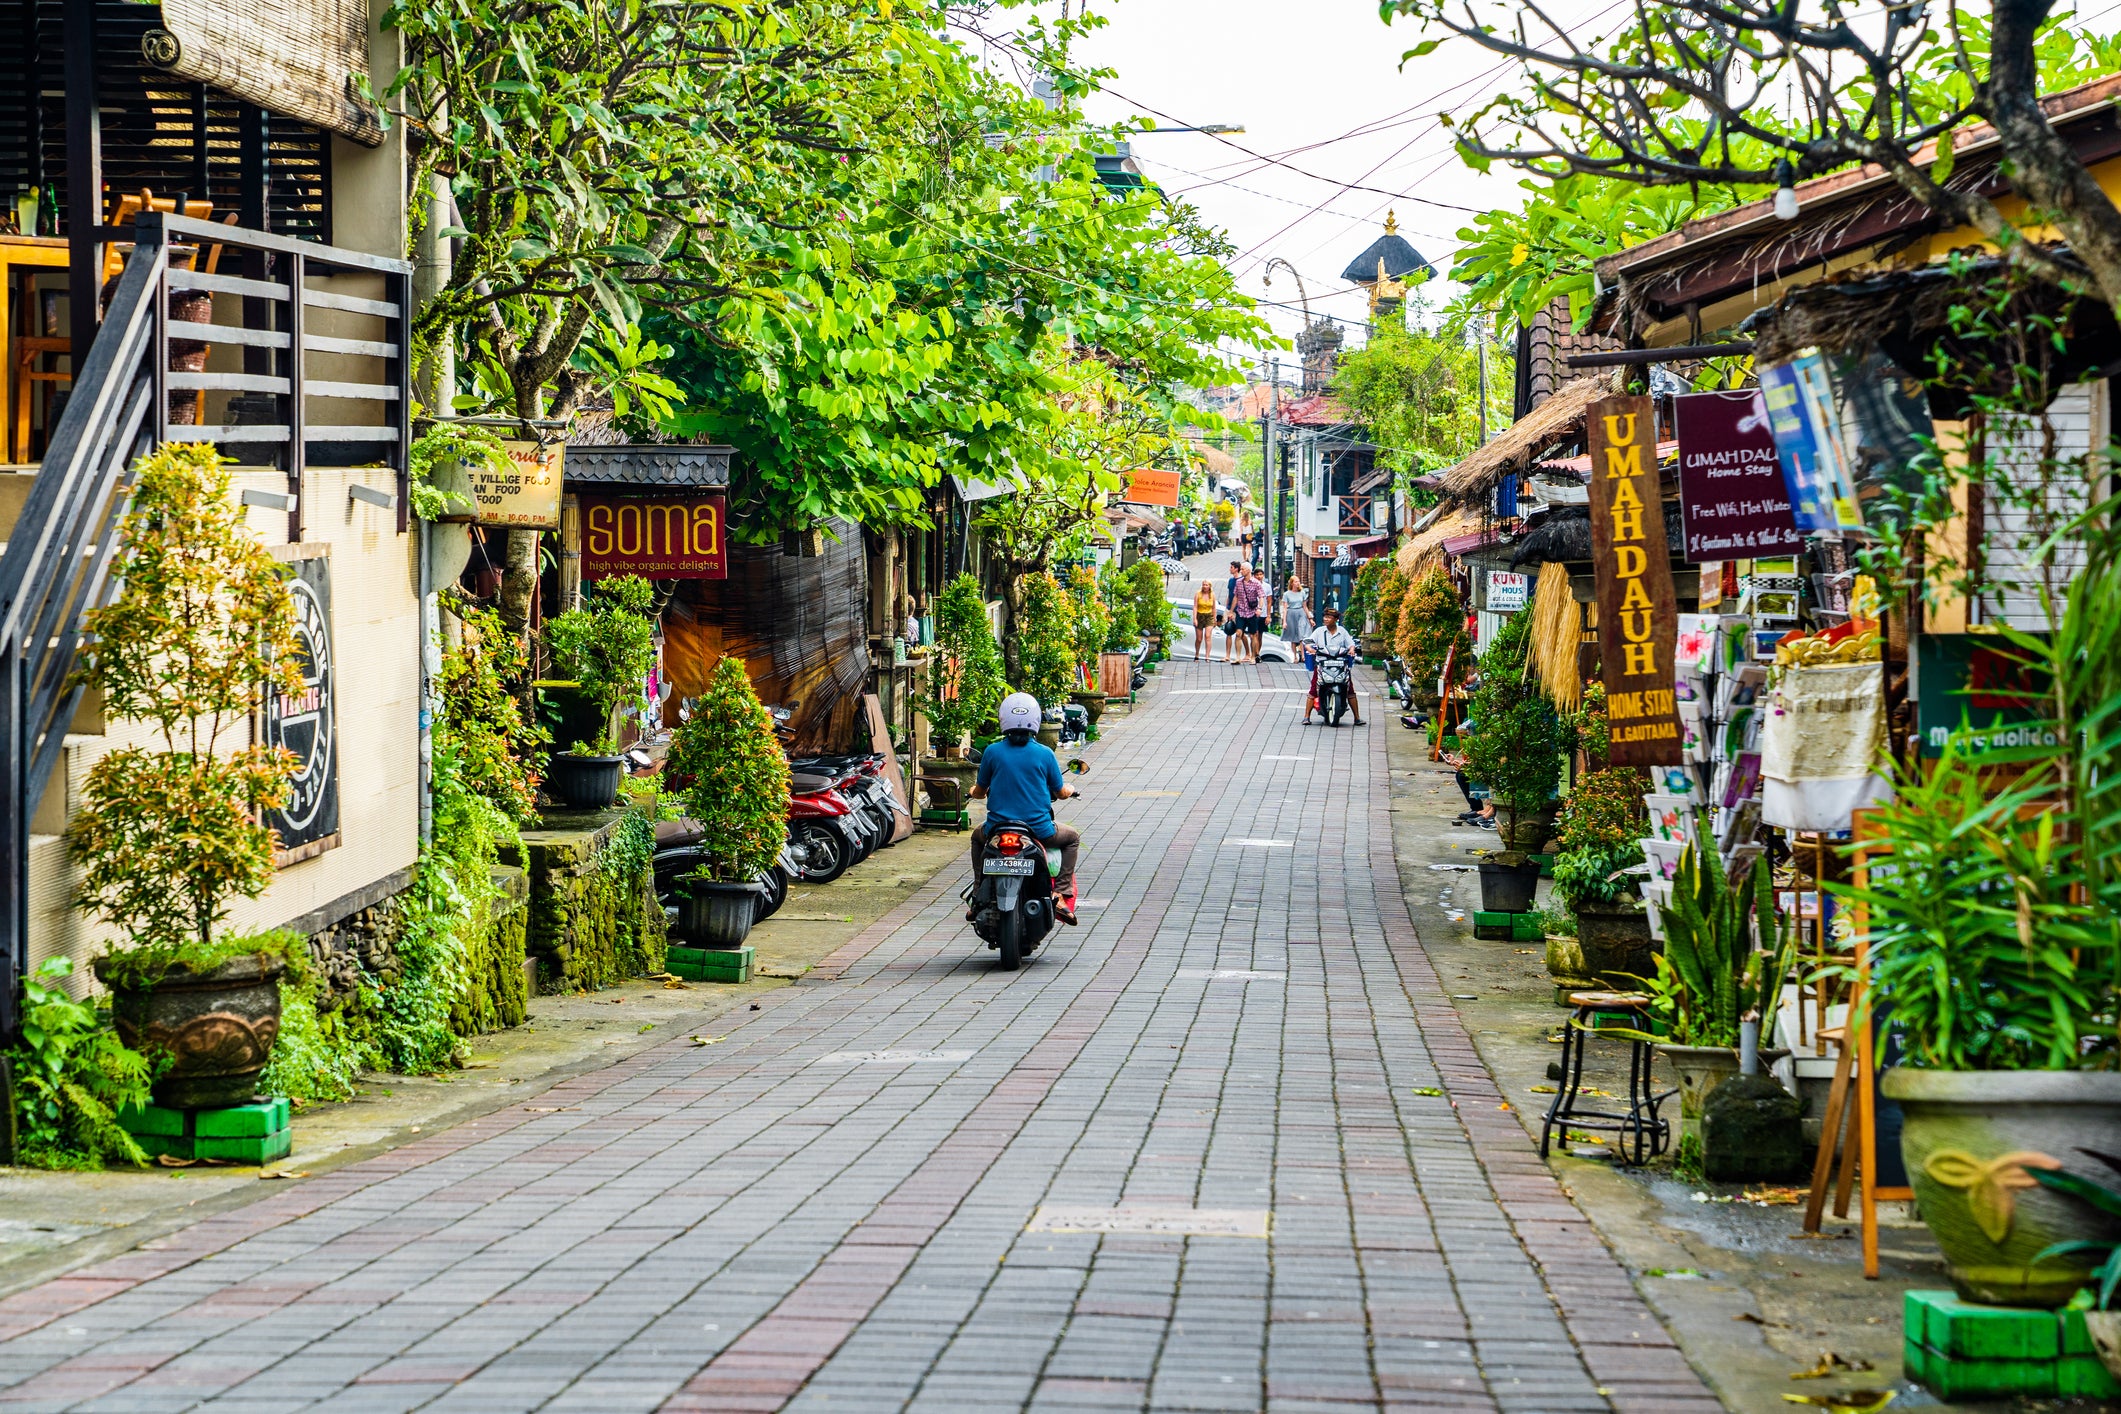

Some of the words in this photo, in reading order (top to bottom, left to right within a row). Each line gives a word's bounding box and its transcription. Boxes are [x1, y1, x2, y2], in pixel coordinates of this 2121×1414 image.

[1707, 468, 1742, 478] Home
[1745, 464, 1773, 477] Stay
[495, 485, 521, 495] FOOD
[1692, 504, 1716, 520] Free
[1740, 500, 1762, 516] Hot
[588, 504, 719, 556] soma
[589, 560, 611, 572] high
[613, 560, 636, 570] vibe
[638, 560, 676, 572] organic
[678, 560, 719, 572] delights
[1607, 692, 1644, 720] HOME
[1645, 689, 1675, 717] STAY
